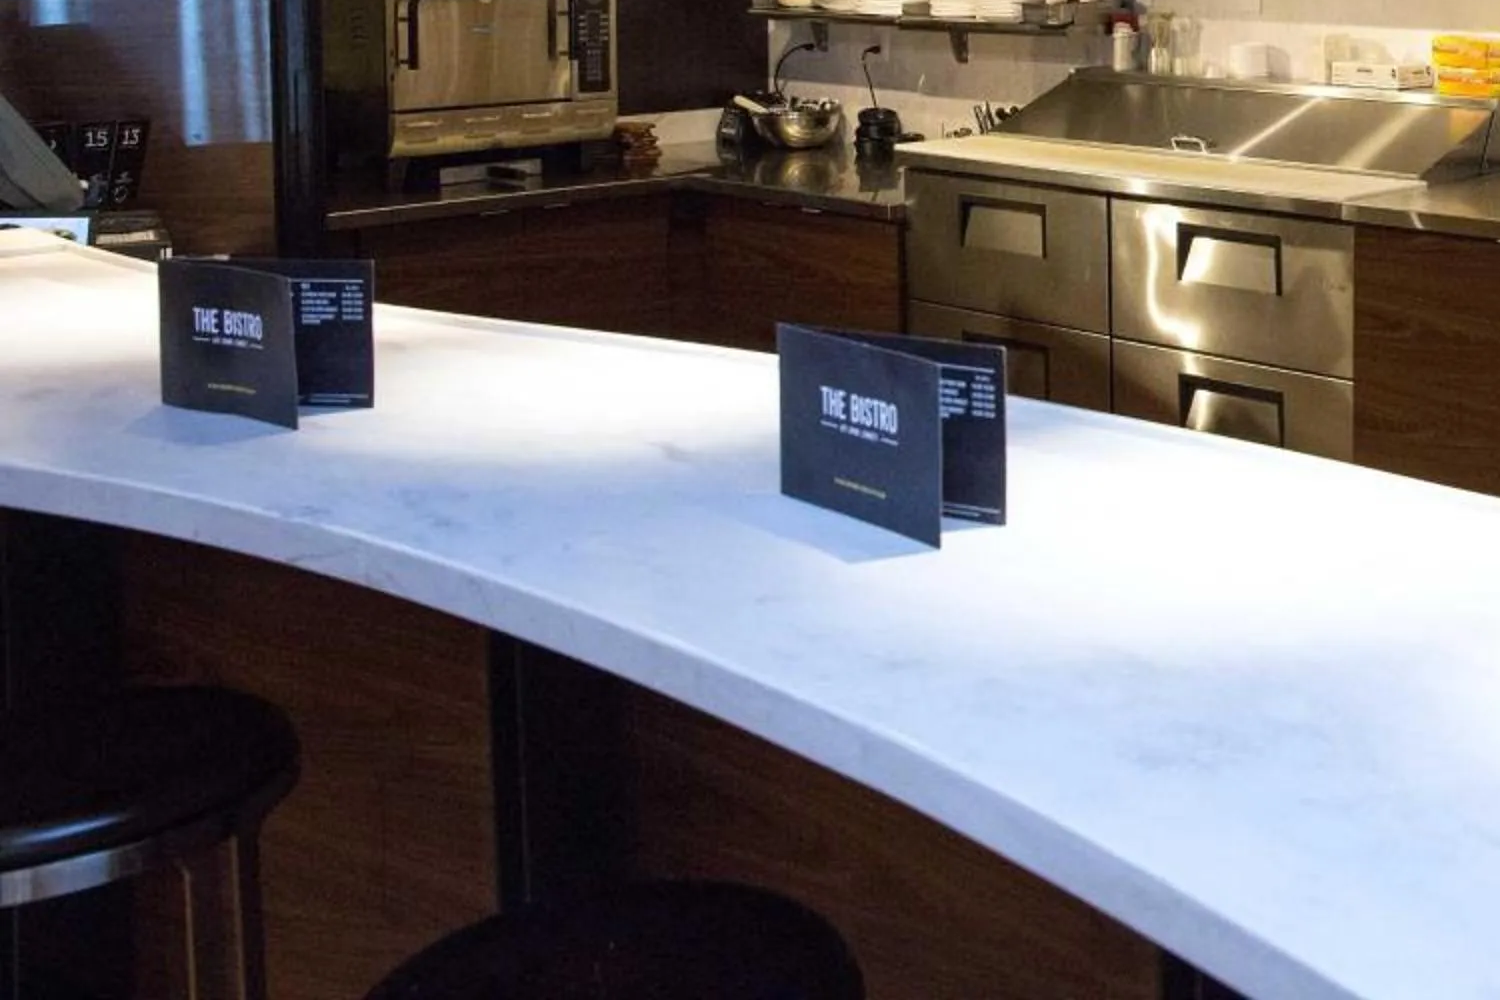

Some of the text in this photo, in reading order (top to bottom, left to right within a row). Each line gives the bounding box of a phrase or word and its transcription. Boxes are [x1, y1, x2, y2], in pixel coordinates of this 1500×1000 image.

[84, 131, 108, 148] 15
[192, 307, 264, 341] THE BISTRO
[820, 385, 848, 420] THE
[850, 393, 899, 435] BISTRO
